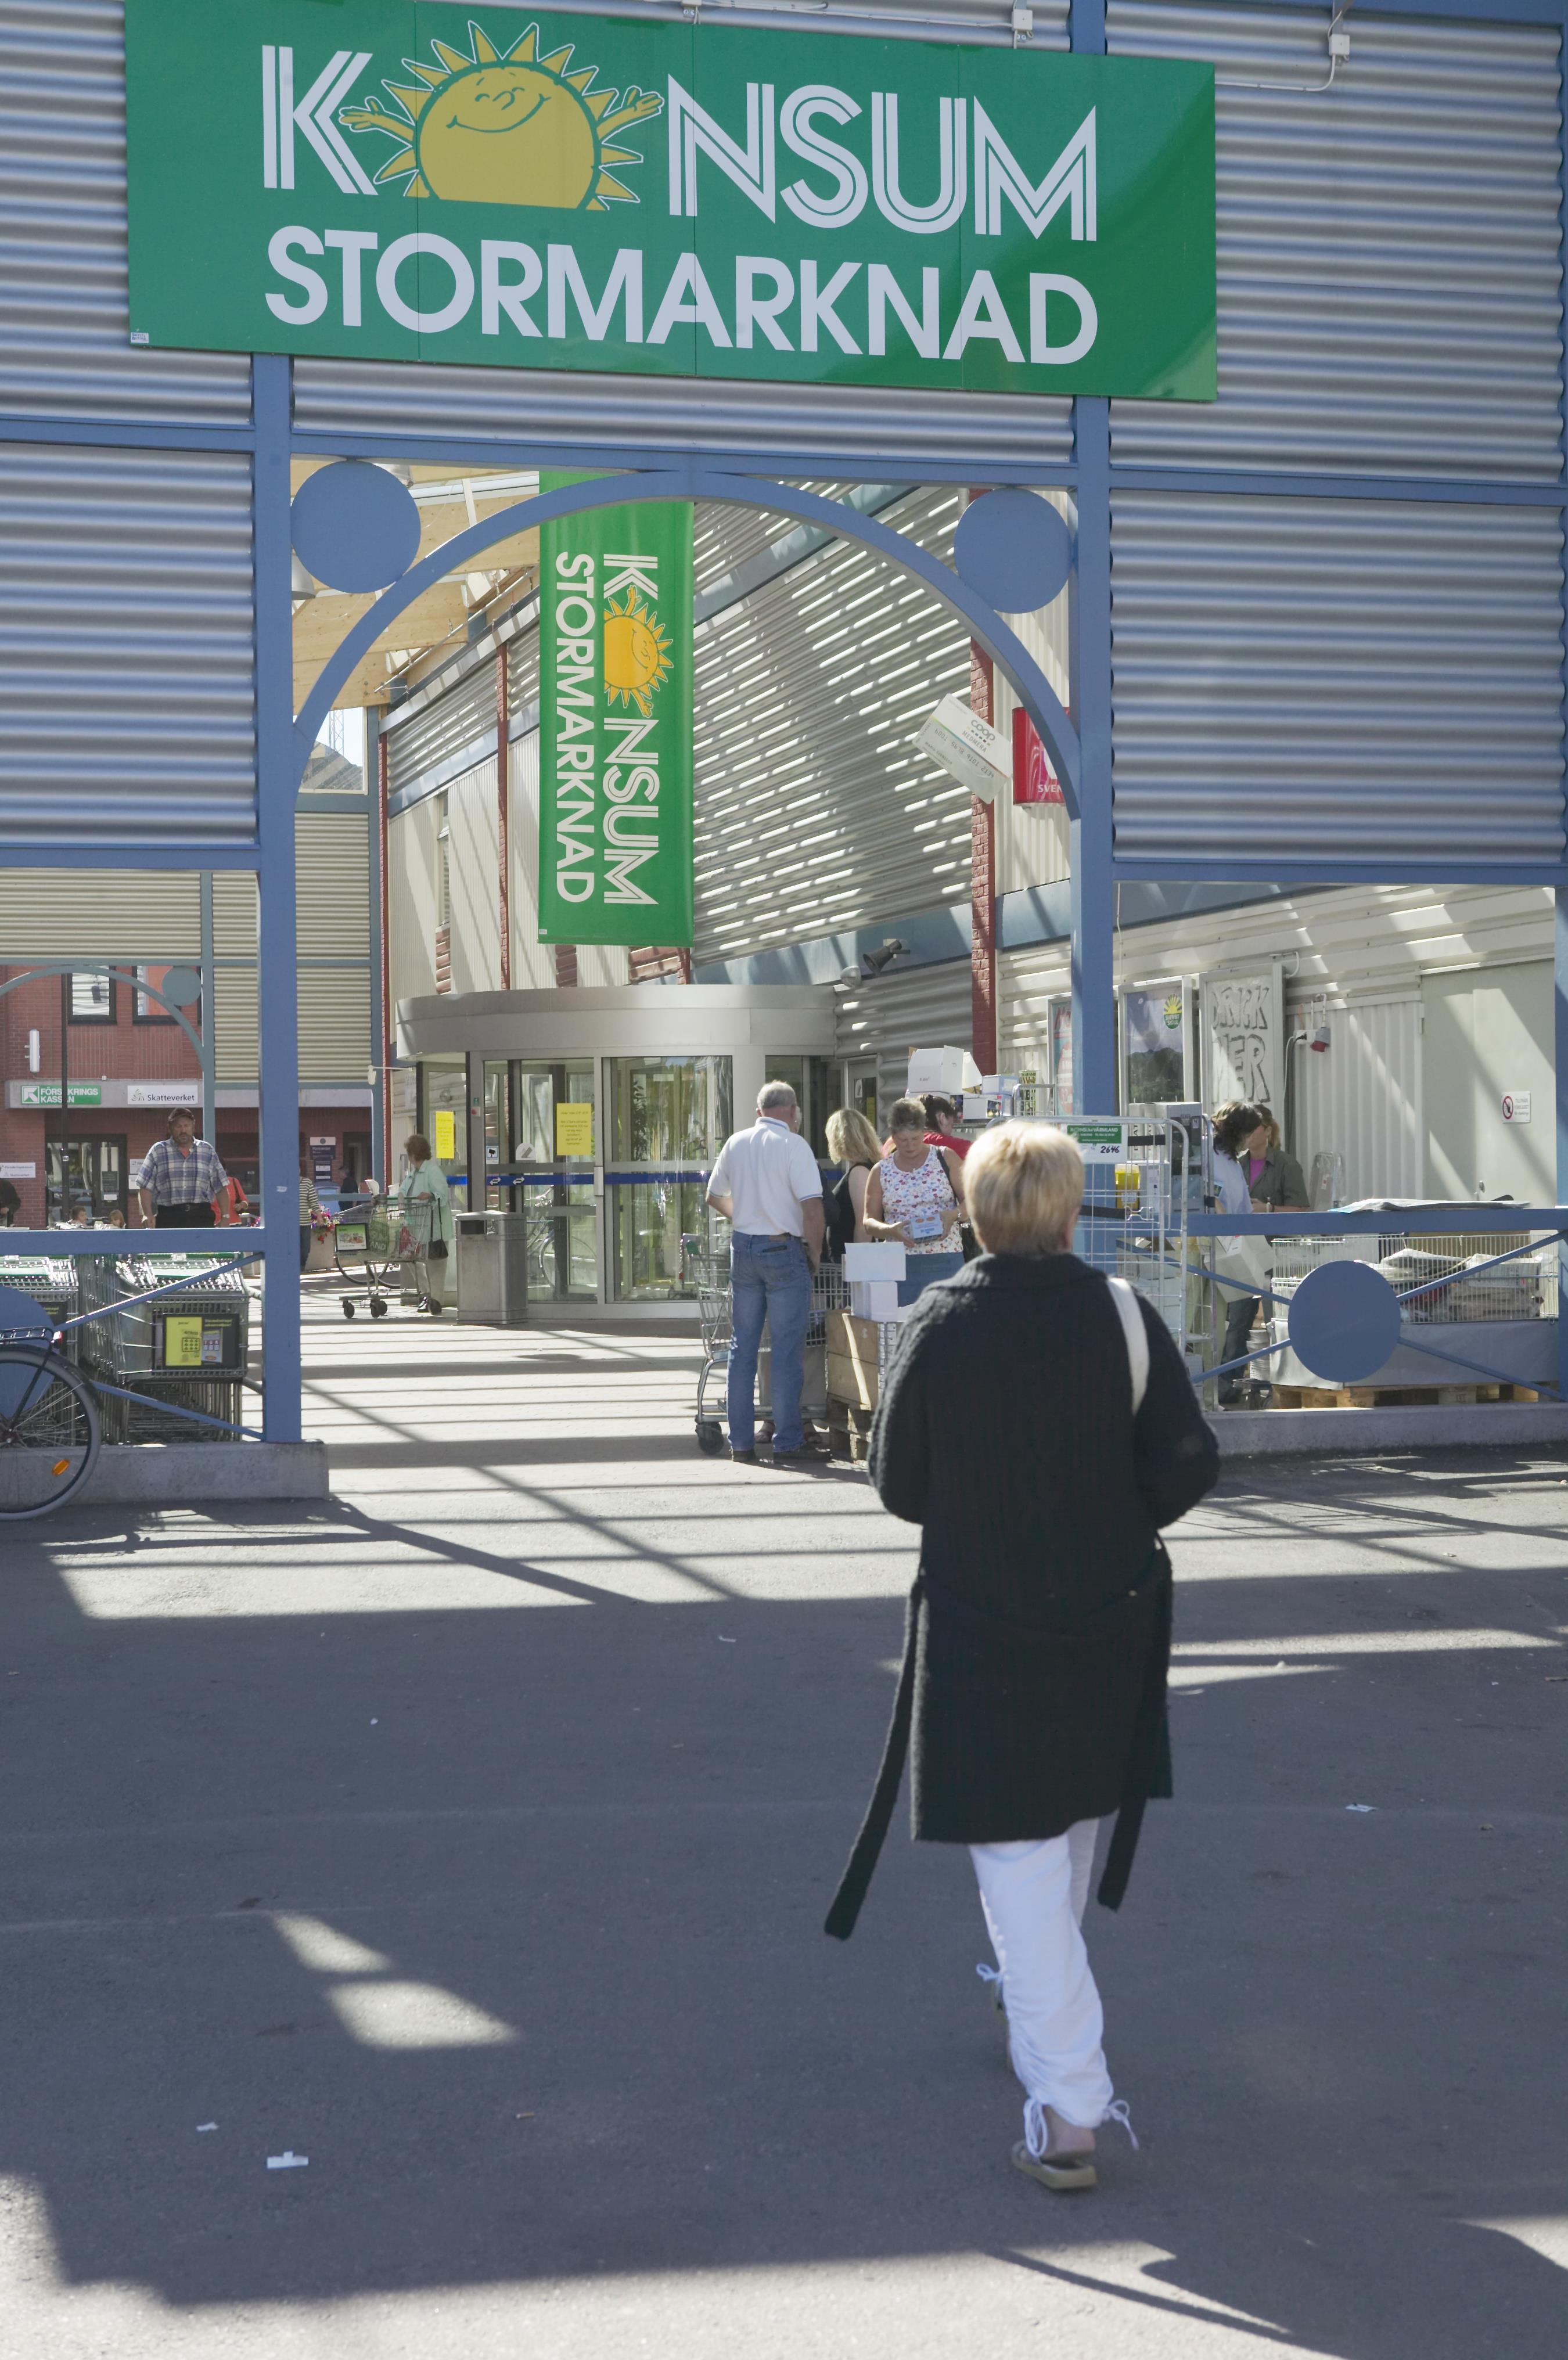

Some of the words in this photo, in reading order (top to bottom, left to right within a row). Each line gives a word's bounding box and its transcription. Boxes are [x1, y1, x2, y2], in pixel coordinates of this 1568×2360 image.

[265, 225, 1098, 365] STORMARKNAD
[555, 551, 595, 902] STORMARKNAD
[962, 731, 987, 753] MEDMERA
[41, 1087, 98, 1095] FÖRSKRINGS
[1100, 1145, 1120, 1154] 2646
